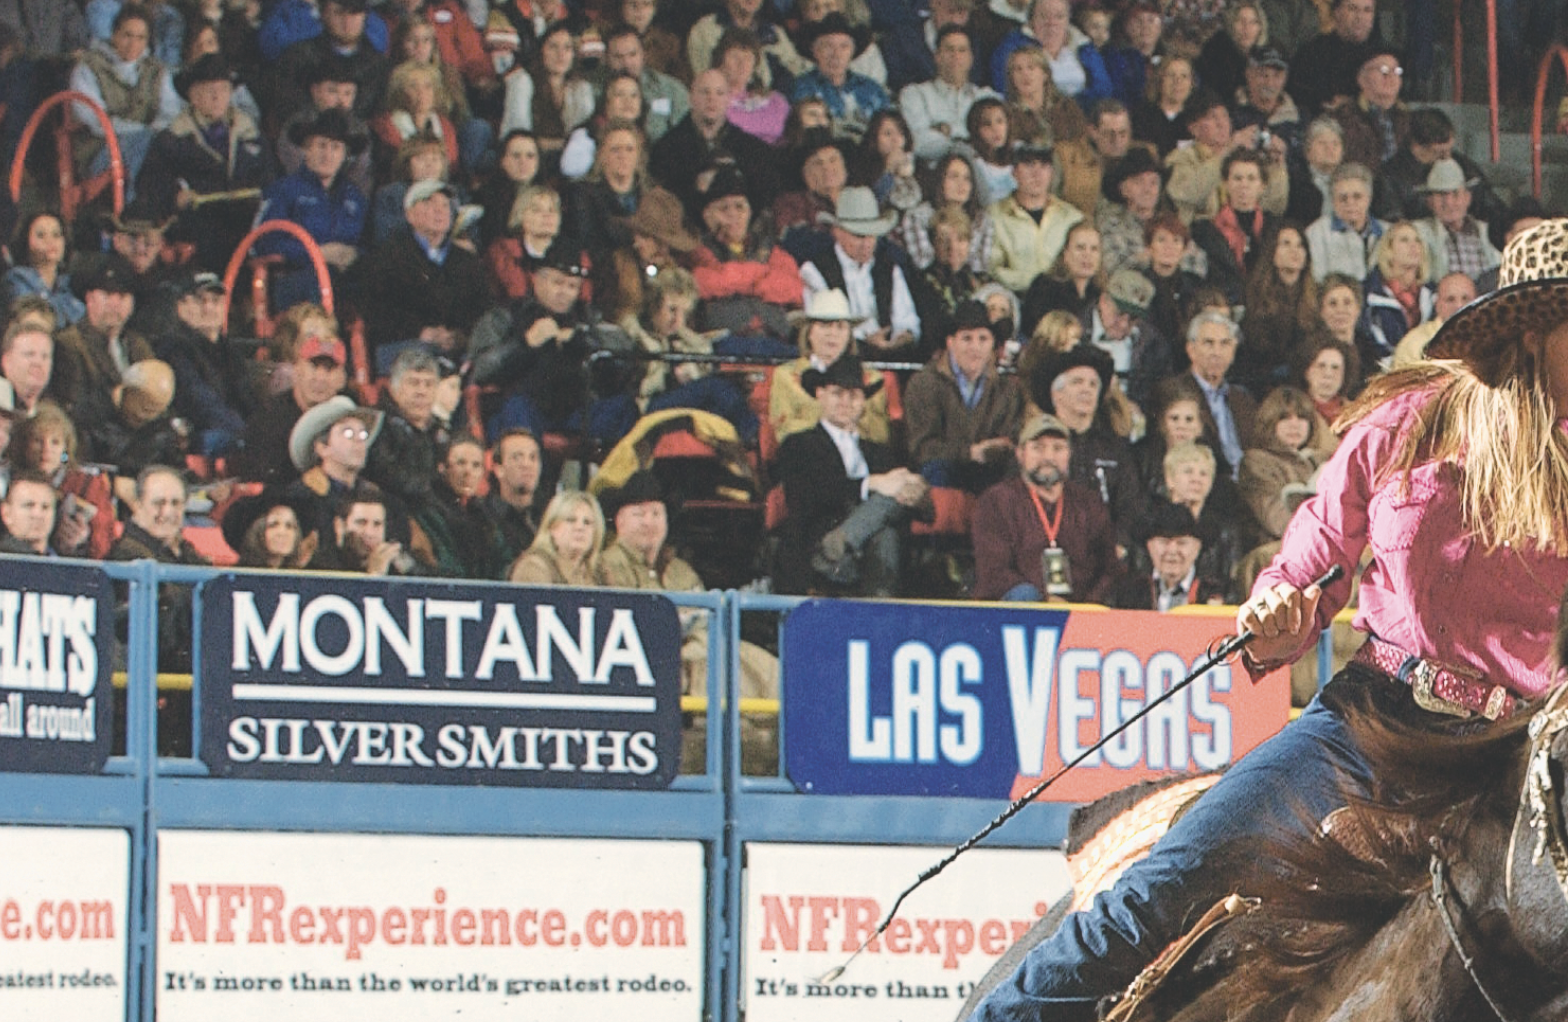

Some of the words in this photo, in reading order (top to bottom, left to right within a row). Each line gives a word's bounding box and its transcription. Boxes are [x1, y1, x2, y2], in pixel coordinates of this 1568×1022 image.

[231, 591, 656, 687] MONTANA
[27, 697, 96, 742] around
[848, 639, 983, 766] LAS
[1001, 624, 1233, 778] VEGAS
[169, 884, 688, 960] NFRexperience.com
[165, 972, 206, 990] It's
[213, 978, 283, 991] more
[290, 973, 351, 991] than
[360, 973, 401, 991] the
[409, 974, 498, 992] world's
[505, 975, 610, 995] greatest
[617, 974, 692, 992] rodeo.
[755, 978, 798, 996] It's
[806, 983, 878, 998] more
[886, 979, 950, 998] than
